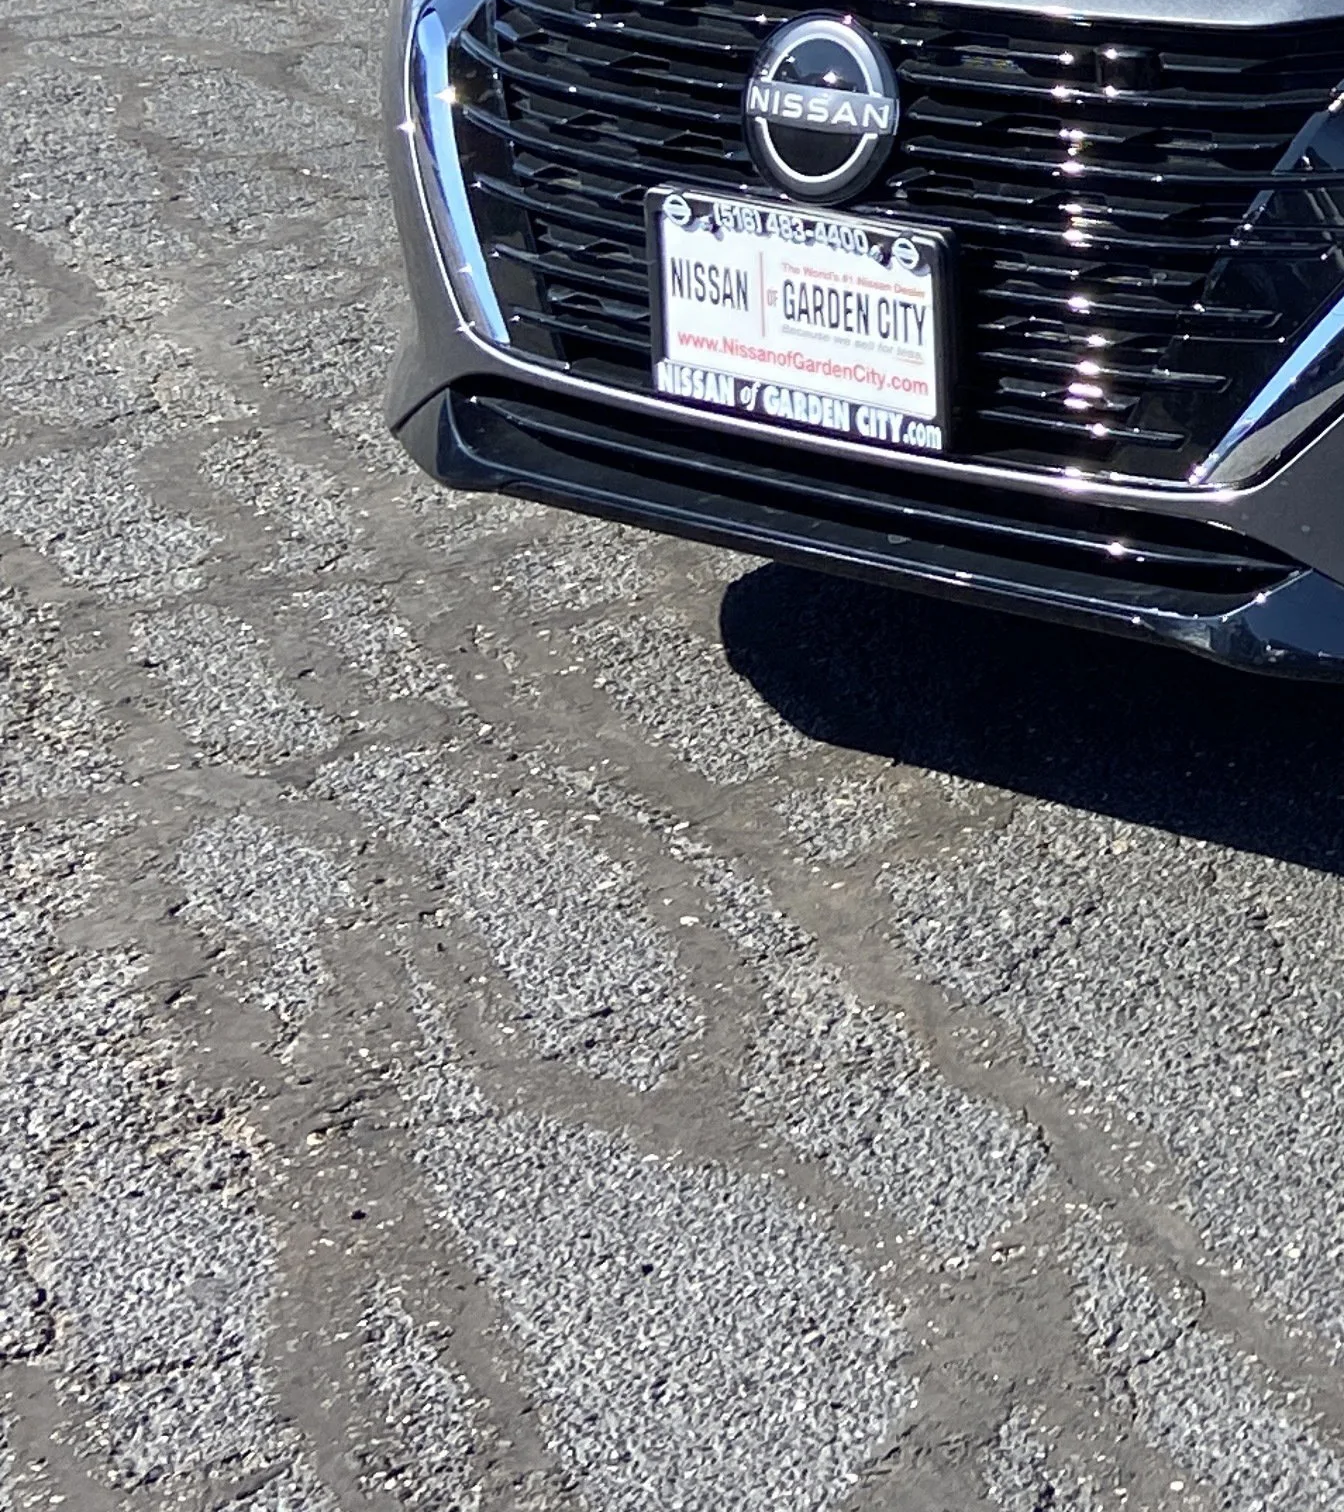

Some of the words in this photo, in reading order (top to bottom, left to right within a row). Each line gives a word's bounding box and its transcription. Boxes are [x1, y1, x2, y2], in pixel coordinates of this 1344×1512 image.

[750, 85, 890, 129] NISSAN
[713, 201, 763, 235] (516)
[766, 213, 869, 255] 483-4400
[670, 256, 749, 312] NISSAN
[767, 289, 779, 308] OF
[782, 278, 870, 336] GARDEN
[877, 296, 927, 346] CITY
[677, 329, 930, 397] www.NissanofGardenCity.com
[657, 361, 736, 407] NISSAN
[739, 380, 761, 411] of
[763, 384, 851, 432] GARDEN
[855, 405, 943, 450] CITY.com
